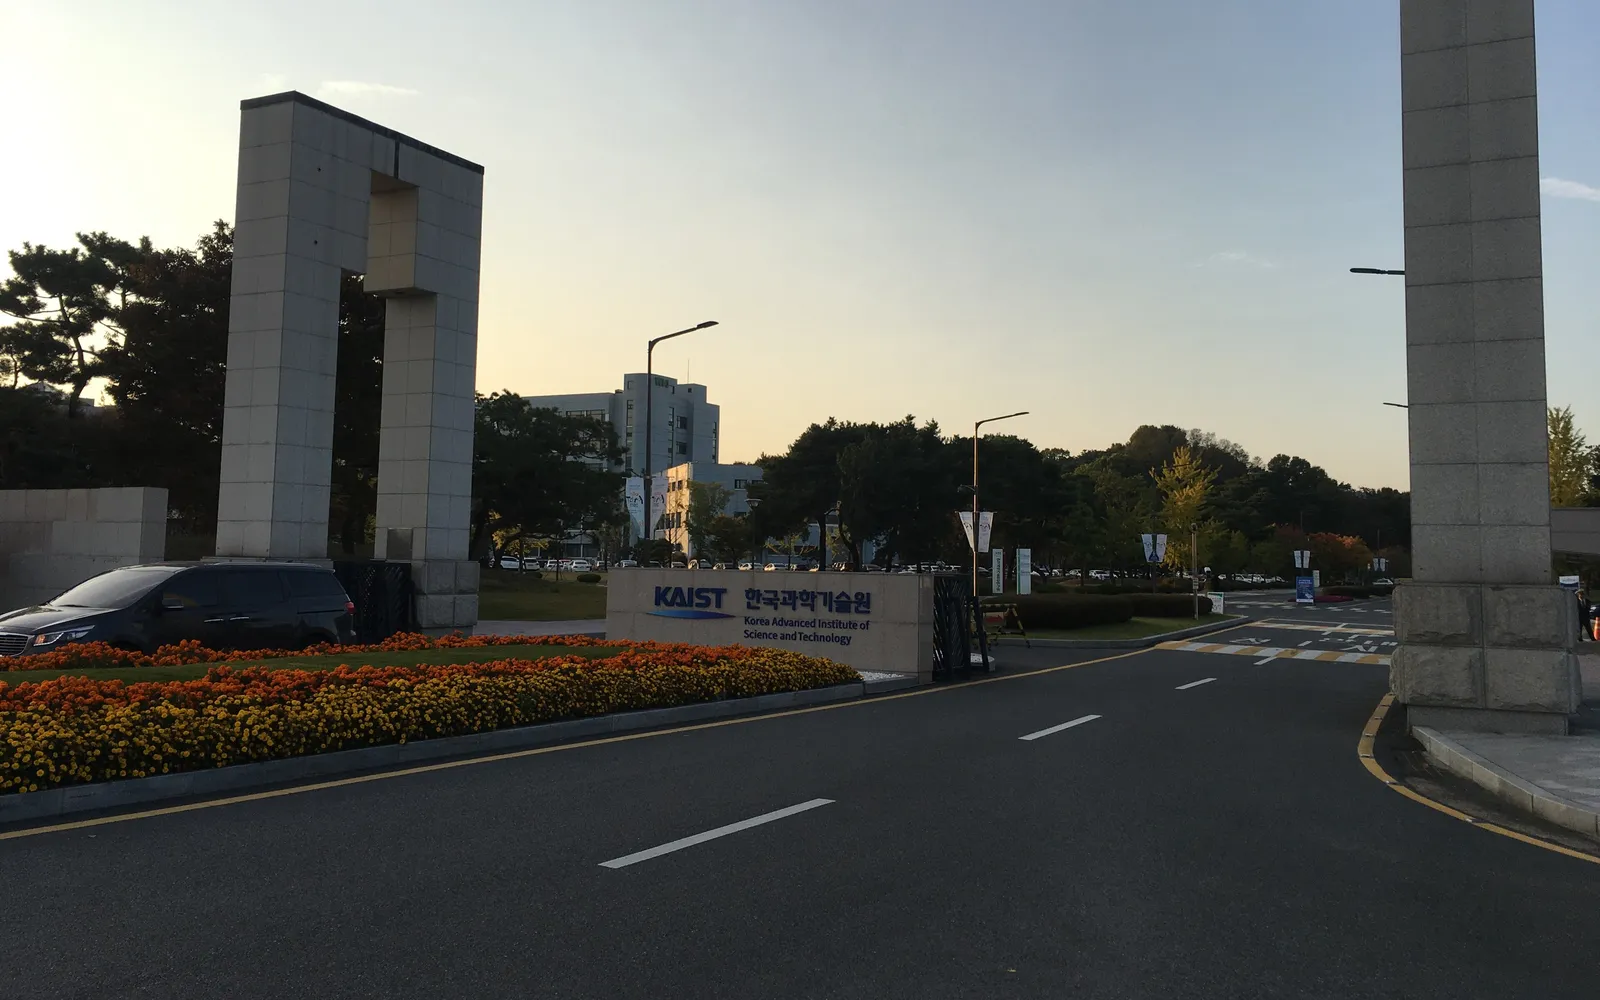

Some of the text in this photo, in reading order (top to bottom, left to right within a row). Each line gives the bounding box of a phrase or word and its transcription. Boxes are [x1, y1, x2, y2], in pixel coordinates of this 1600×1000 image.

[654, 586, 727, 609] KAIST
[744, 588, 871, 614] 한국과학기술원
[744, 616, 870, 631] Korea Advanced Institute of
[744, 629, 852, 646] Science and Technology
